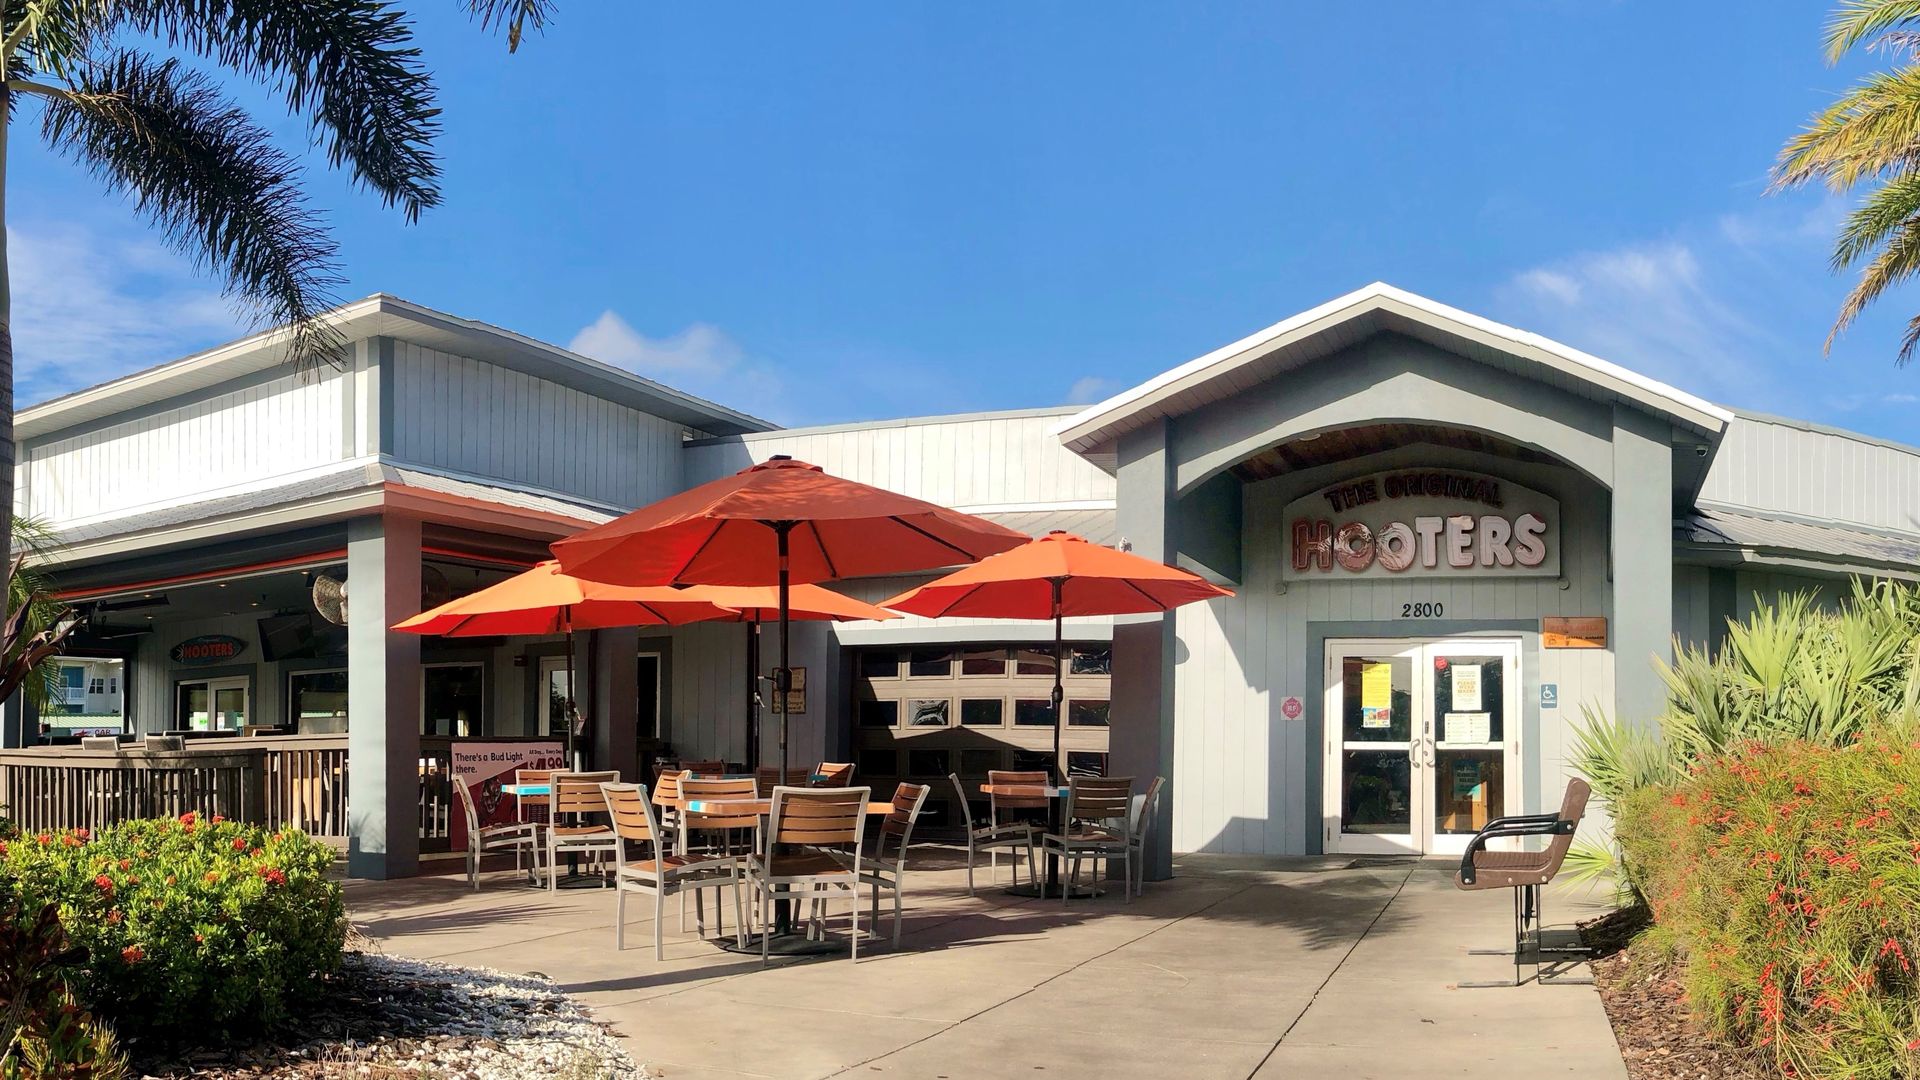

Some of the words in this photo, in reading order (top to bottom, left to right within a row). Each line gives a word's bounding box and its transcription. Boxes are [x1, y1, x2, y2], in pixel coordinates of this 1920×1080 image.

[1323, 479, 1381, 513] THE
[1384, 473, 1504, 510] ORIGINAL
[1291, 513, 1547, 573] HOOTERS
[1401, 602, 1444, 618] 2800
[183, 641, 234, 658] HOOTERS
[455, 752, 482, 762] There's
[483, 754, 488, 762] a
[490, 752, 505, 761] Bud
[505, 751, 523, 763] Light
[455, 764, 478, 774] there.
